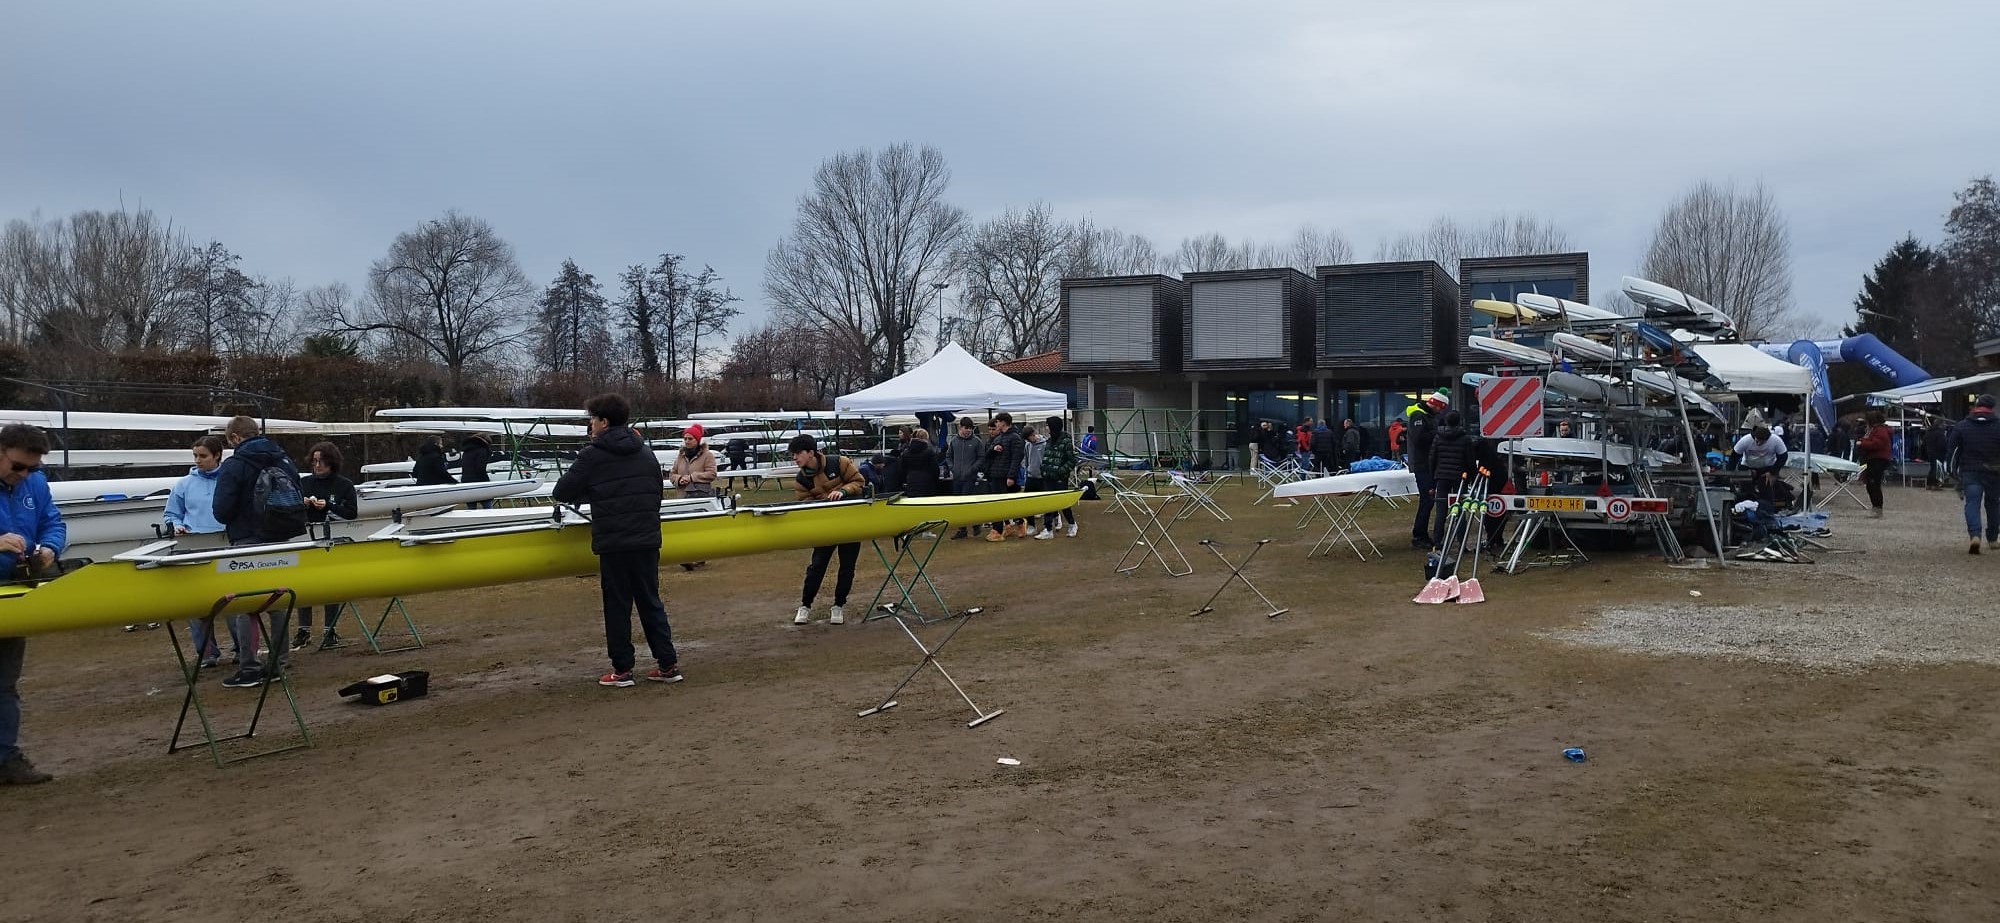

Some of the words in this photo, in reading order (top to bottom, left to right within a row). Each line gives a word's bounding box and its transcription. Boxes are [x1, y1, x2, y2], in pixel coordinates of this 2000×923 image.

[1489, 501, 1501, 510] 70
[1529, 498, 1540, 508] DT
[1546, 499, 1563, 508] 243
[1569, 499, 1580, 509] HF
[1613, 504, 1625, 513] 80
[238, 561, 255, 570] PSA
